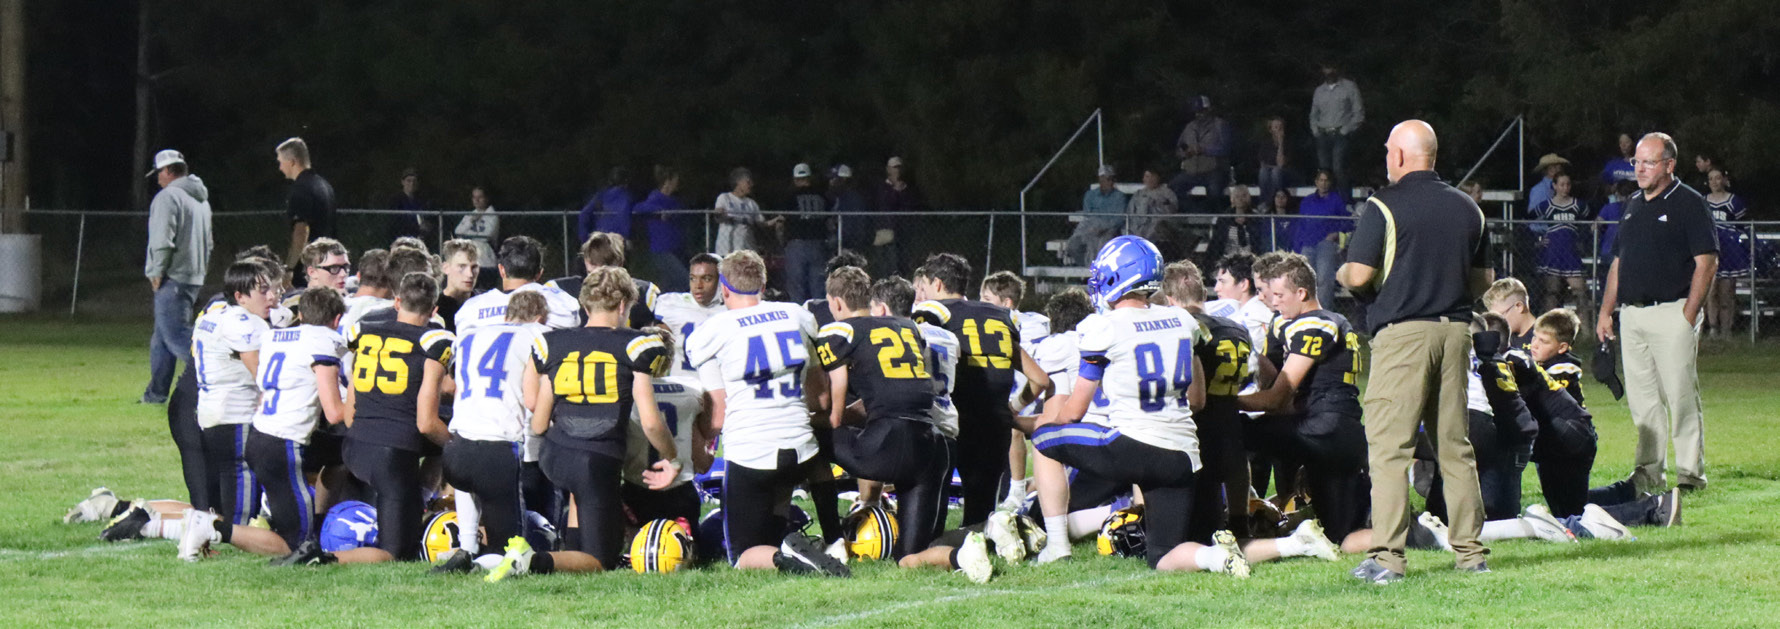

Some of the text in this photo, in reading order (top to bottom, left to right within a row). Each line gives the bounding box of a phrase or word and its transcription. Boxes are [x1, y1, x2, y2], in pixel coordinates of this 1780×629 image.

[272, 330, 301, 342] HYANNIS
[478, 304, 508, 319] HYAN
[736, 310, 789, 327] HYANNIS
[1133, 317, 1182, 332] HYANNIS
[353, 334, 414, 394] 85
[459, 332, 515, 400] 14
[743, 330, 803, 399] 45
[817, 341, 838, 366] 21
[869, 327, 931, 378] 21
[962, 318, 1013, 369] 13
[1300, 335, 1323, 356] 72
[262, 352, 286, 415] 9
[554, 350, 619, 403] 40
[1134, 338, 1192, 413] 84
